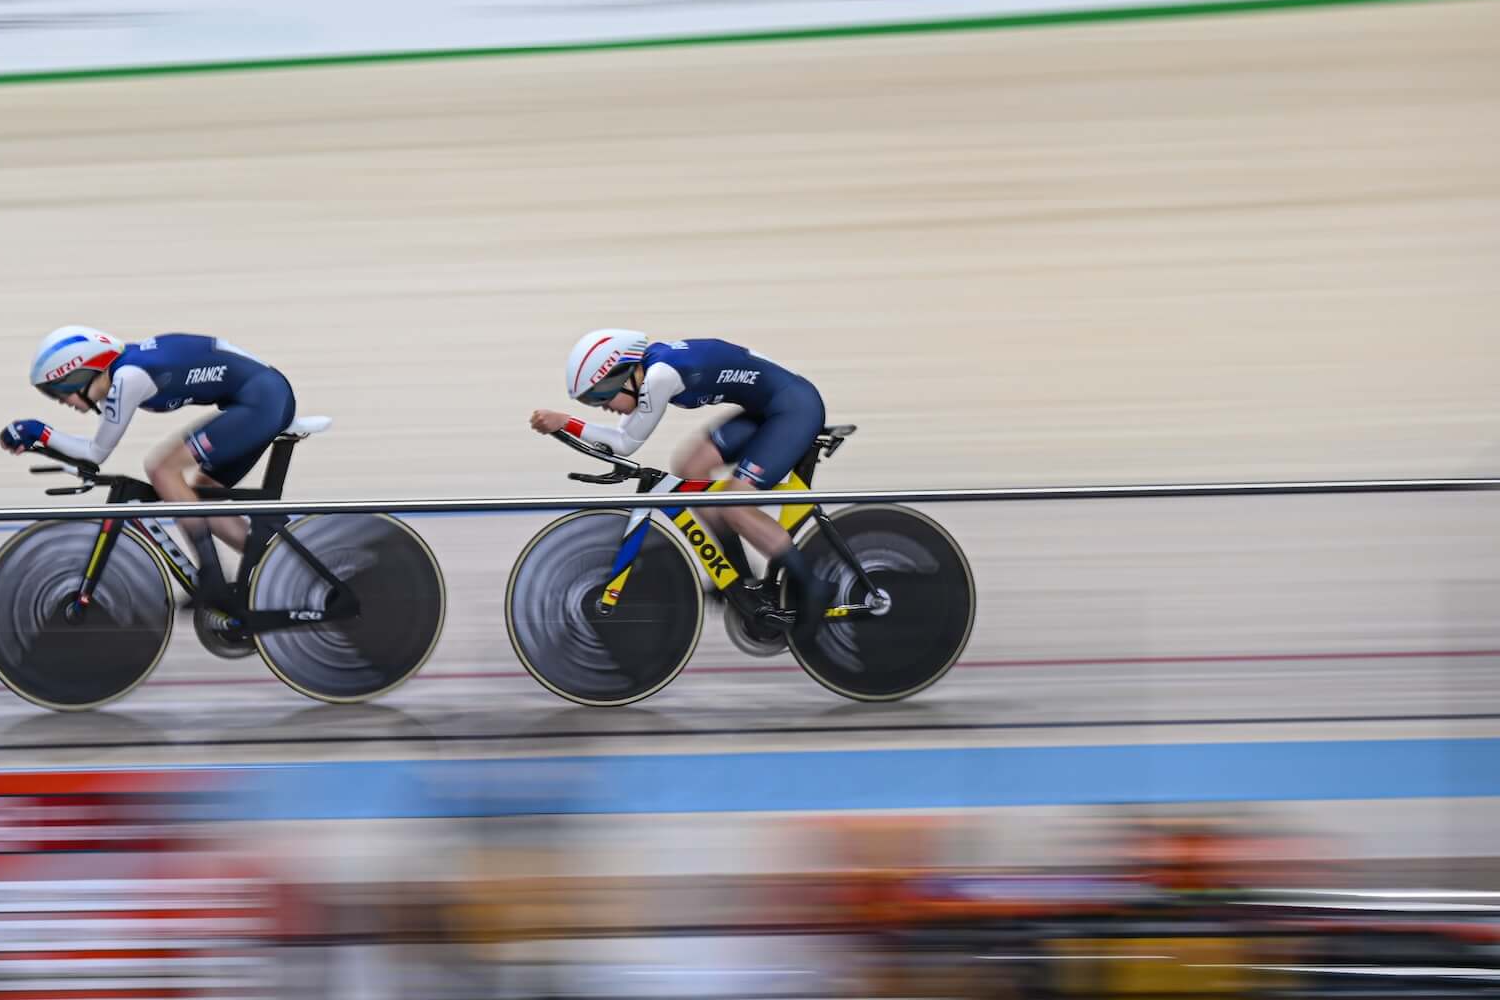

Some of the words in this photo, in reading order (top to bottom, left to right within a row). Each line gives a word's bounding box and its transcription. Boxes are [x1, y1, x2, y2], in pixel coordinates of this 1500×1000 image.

[45, 355, 84, 381] GIRO
[185, 365, 228, 385] FRANCE
[716, 369, 761, 385] FRANCE
[681, 519, 731, 579] LOOK
